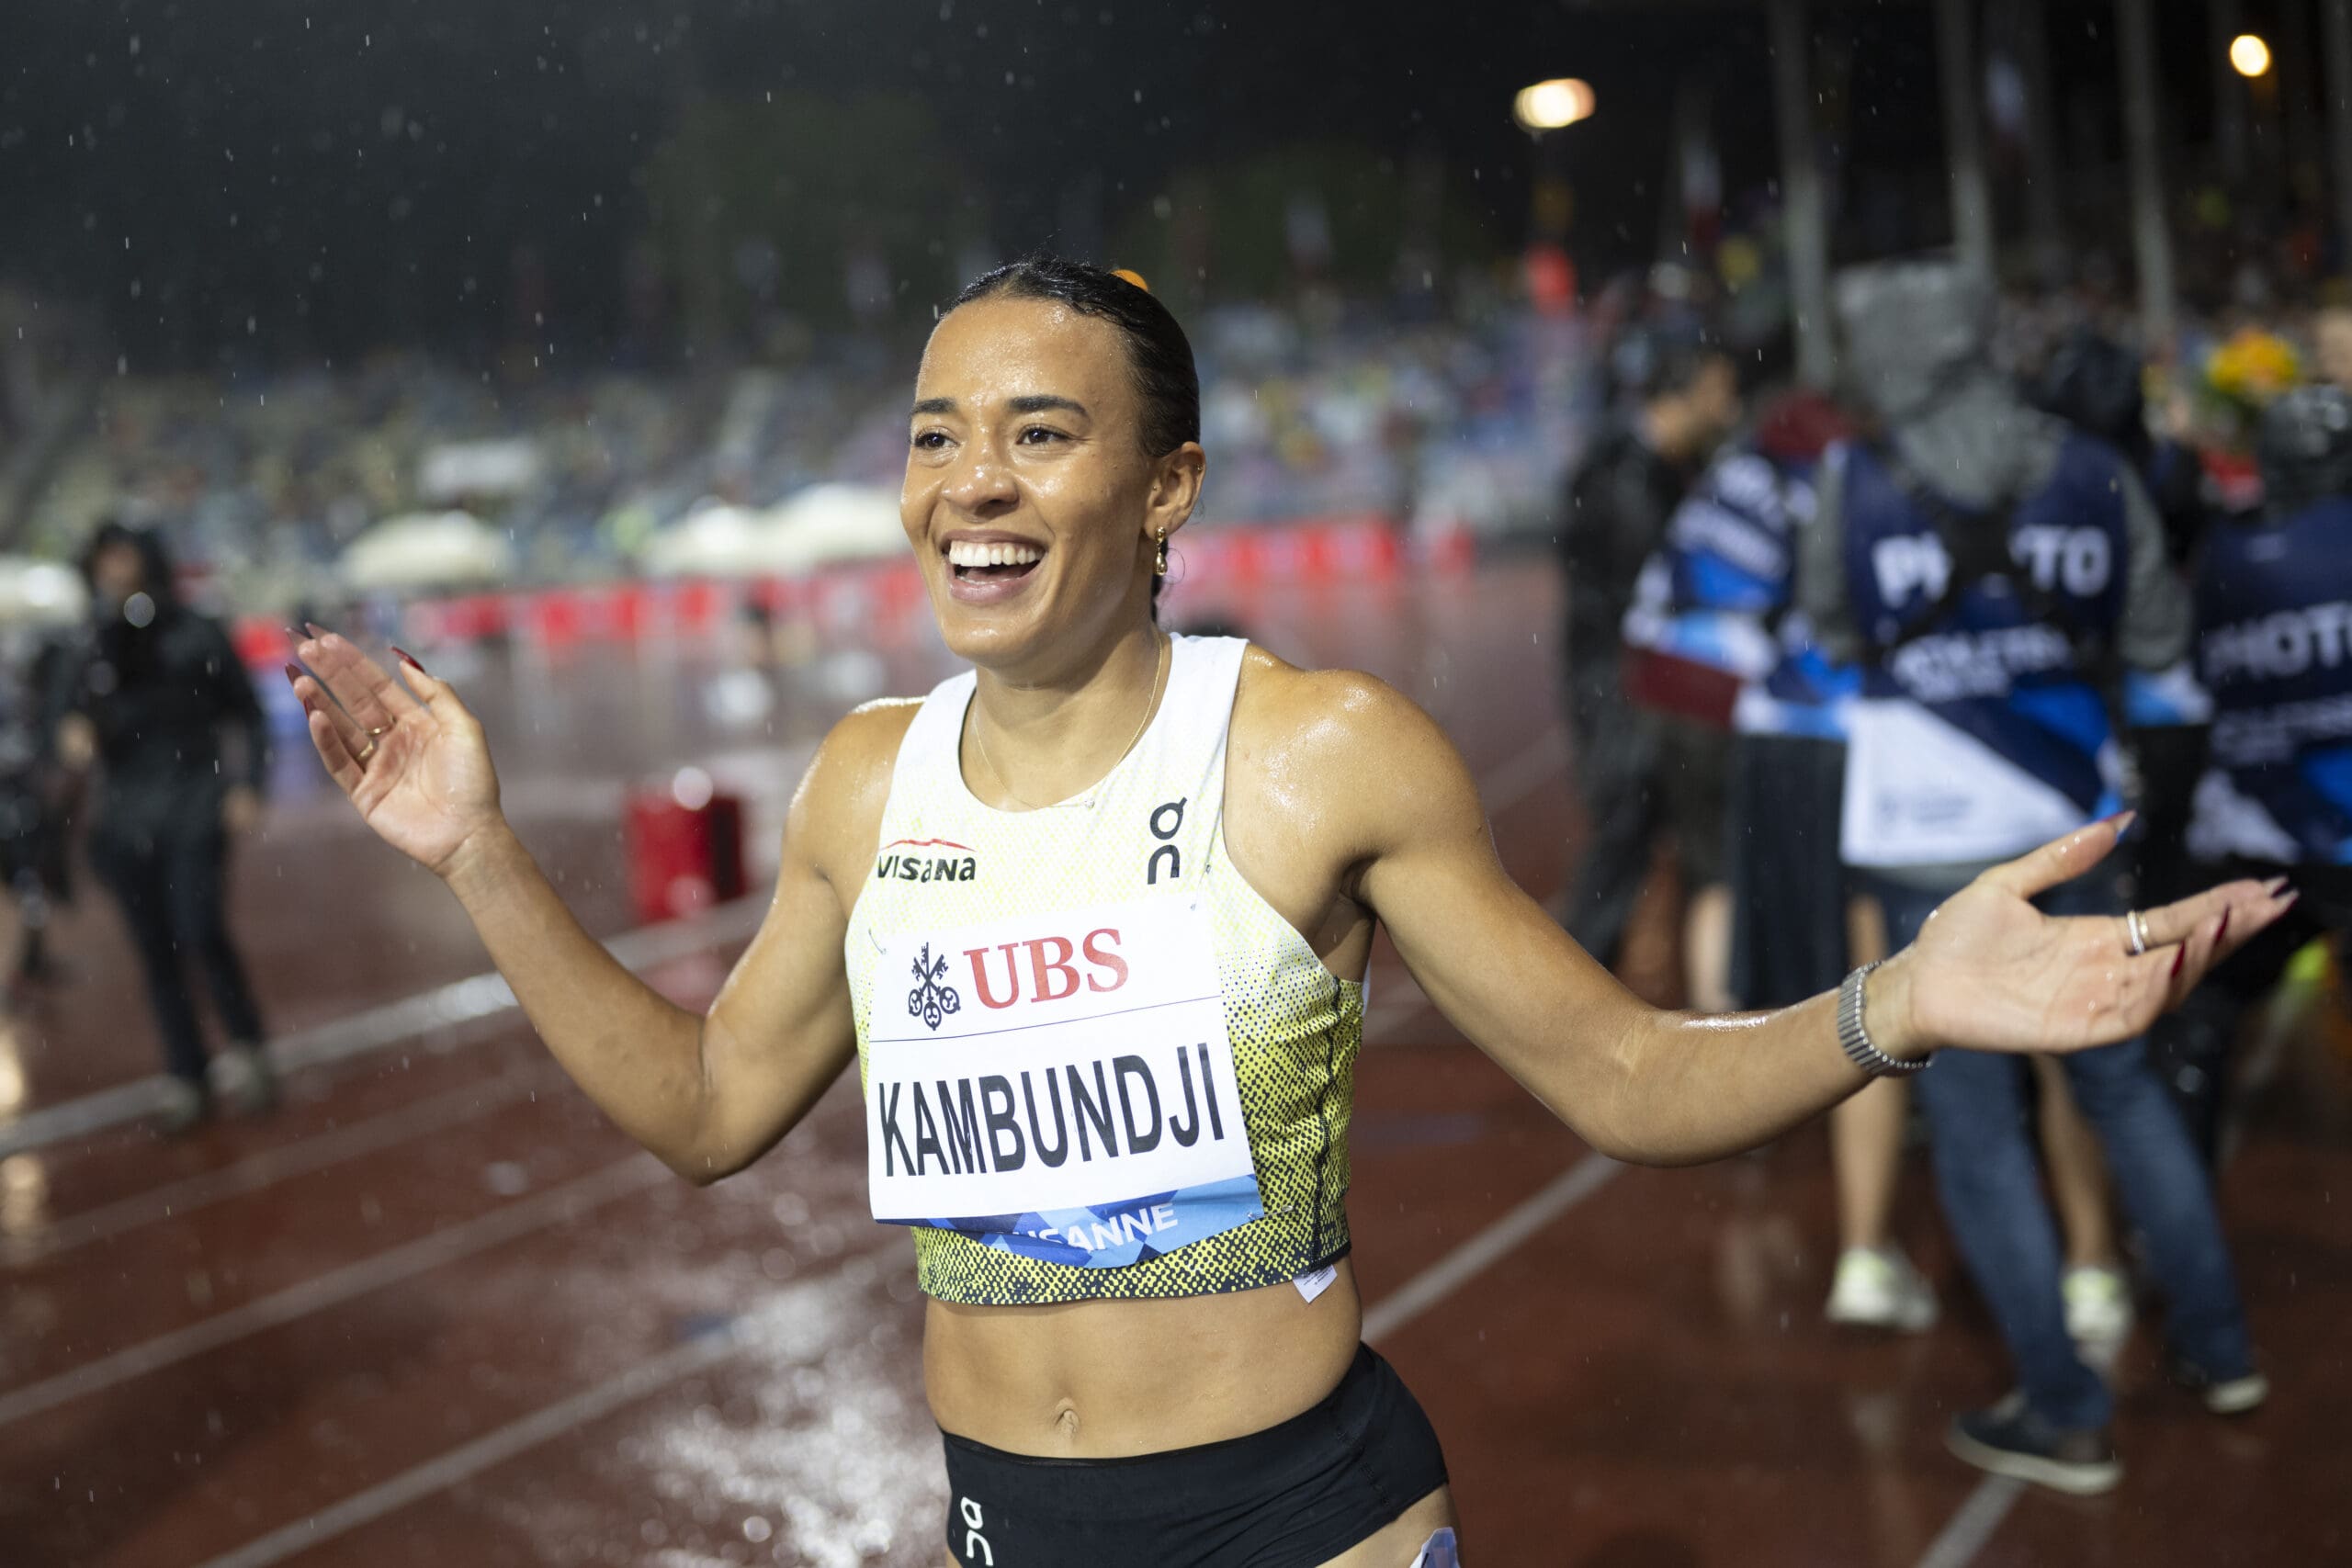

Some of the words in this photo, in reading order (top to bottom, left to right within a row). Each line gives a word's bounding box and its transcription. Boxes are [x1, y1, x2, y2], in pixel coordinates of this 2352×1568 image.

[1872, 524, 2111, 607] PHTO
[2203, 602, 2352, 679] PHOT
[963, 928, 1129, 1010] UBS
[878, 1042, 1224, 1177] KAMBUNDJI
